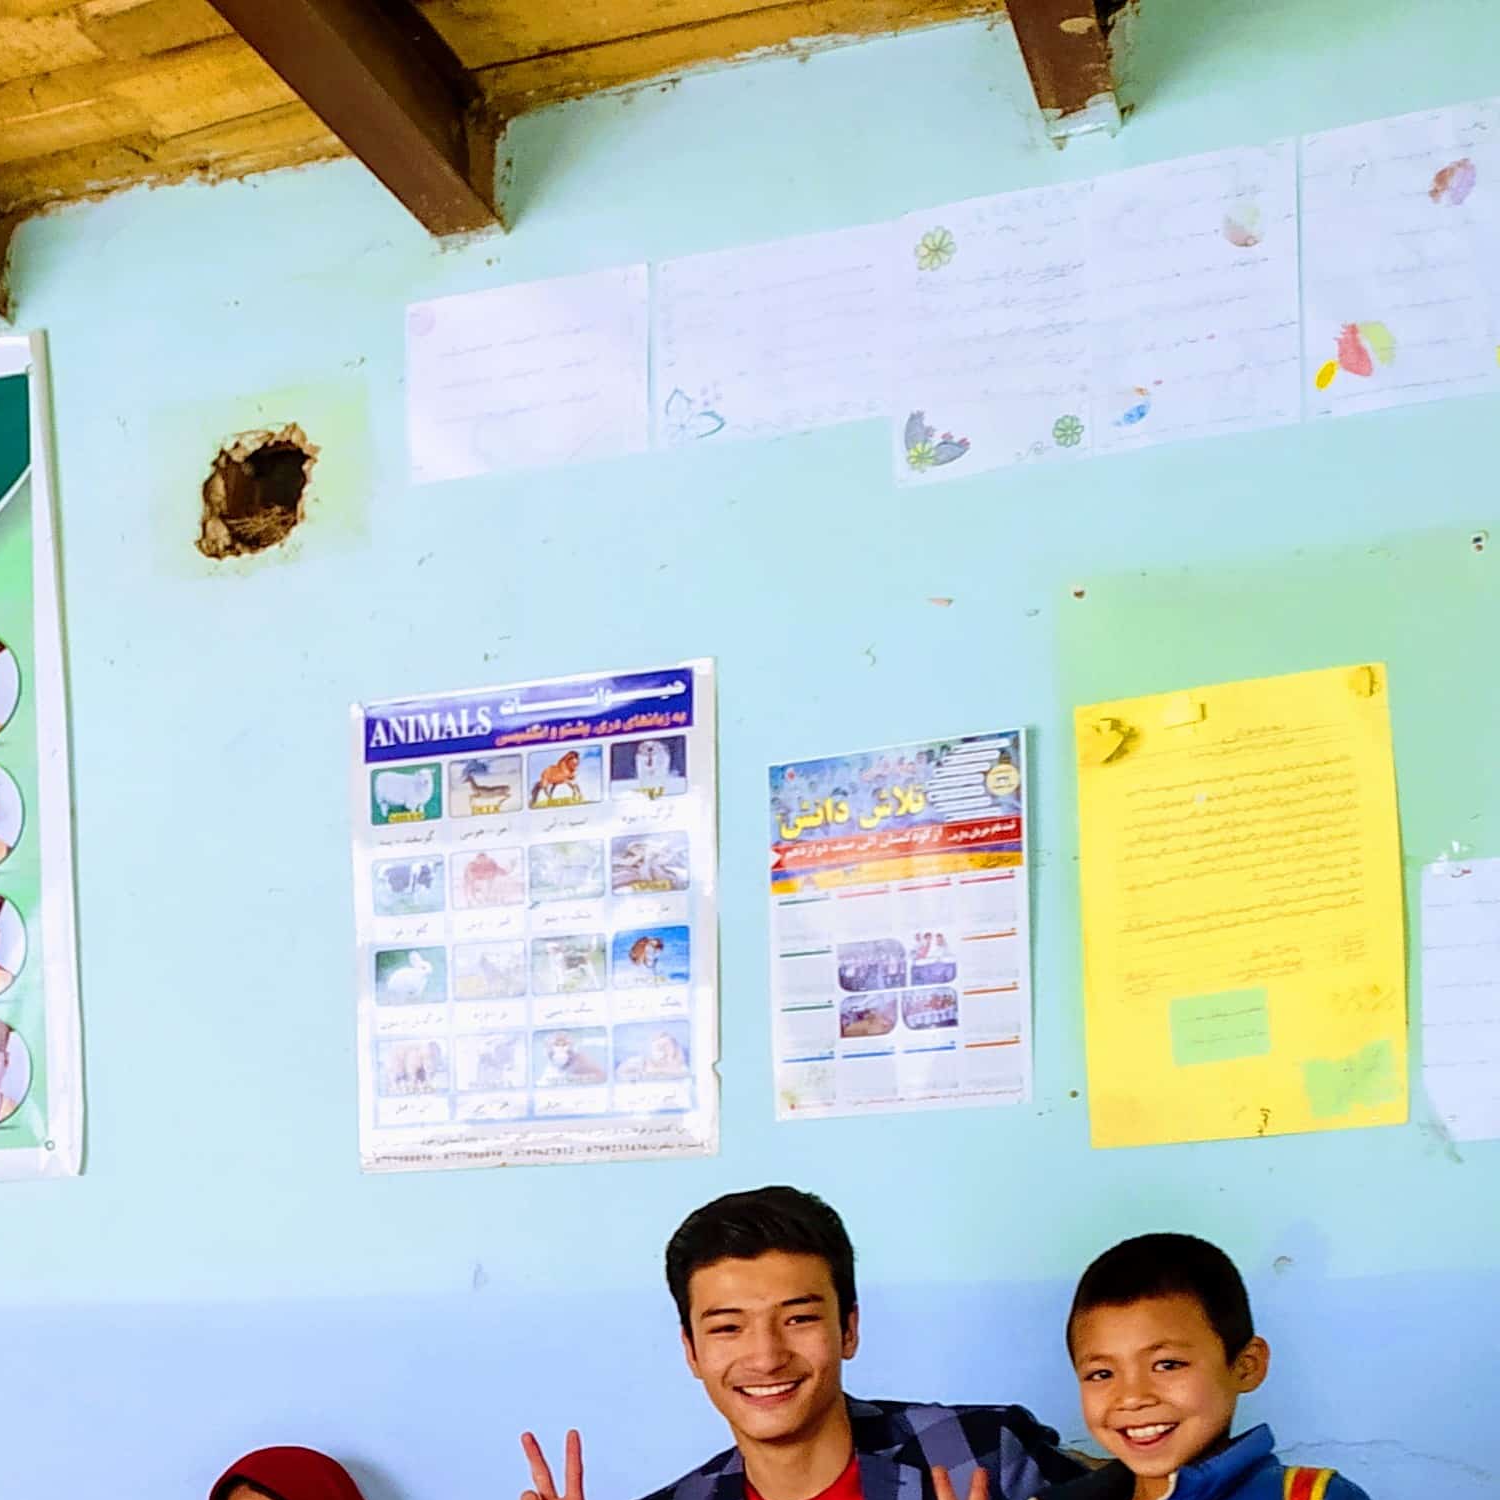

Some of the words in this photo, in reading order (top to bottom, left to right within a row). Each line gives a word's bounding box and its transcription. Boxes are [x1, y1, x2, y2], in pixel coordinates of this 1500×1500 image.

[369, 706, 493, 748] ANIMALS
[774, 796, 851, 841] دانش
[858, 783, 927, 830] تلاش
